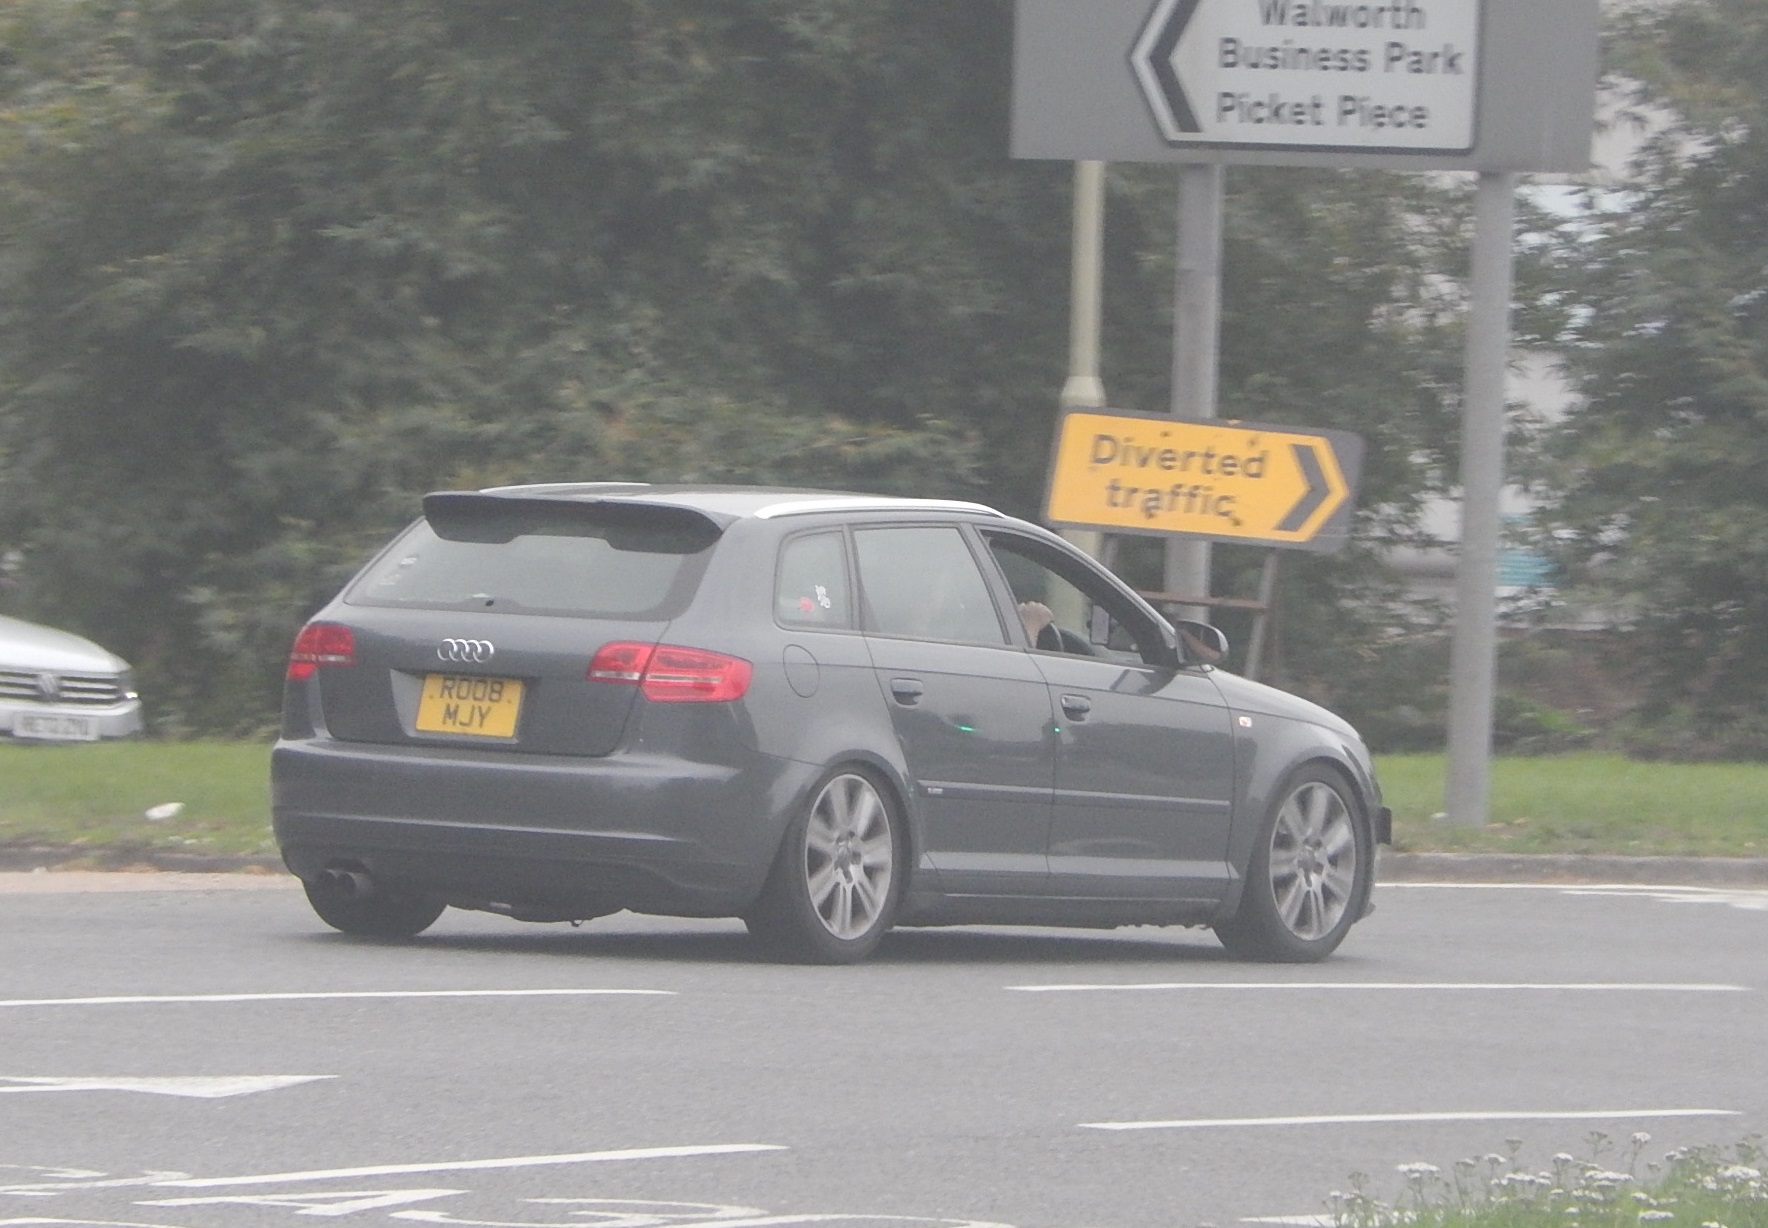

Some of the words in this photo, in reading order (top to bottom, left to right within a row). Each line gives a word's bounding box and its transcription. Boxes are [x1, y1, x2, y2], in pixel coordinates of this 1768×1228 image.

[1258, 0, 1427, 29] Walworth
[1218, 36, 1371, 71] Business
[1384, 40, 1466, 75] Park
[1216, 91, 1325, 126] Picket
[1337, 94, 1430, 129] Piece
[1091, 432, 1266, 479] Diverted
[1106, 478, 1237, 518] traffic
[441, 703, 492, 729] MJY
